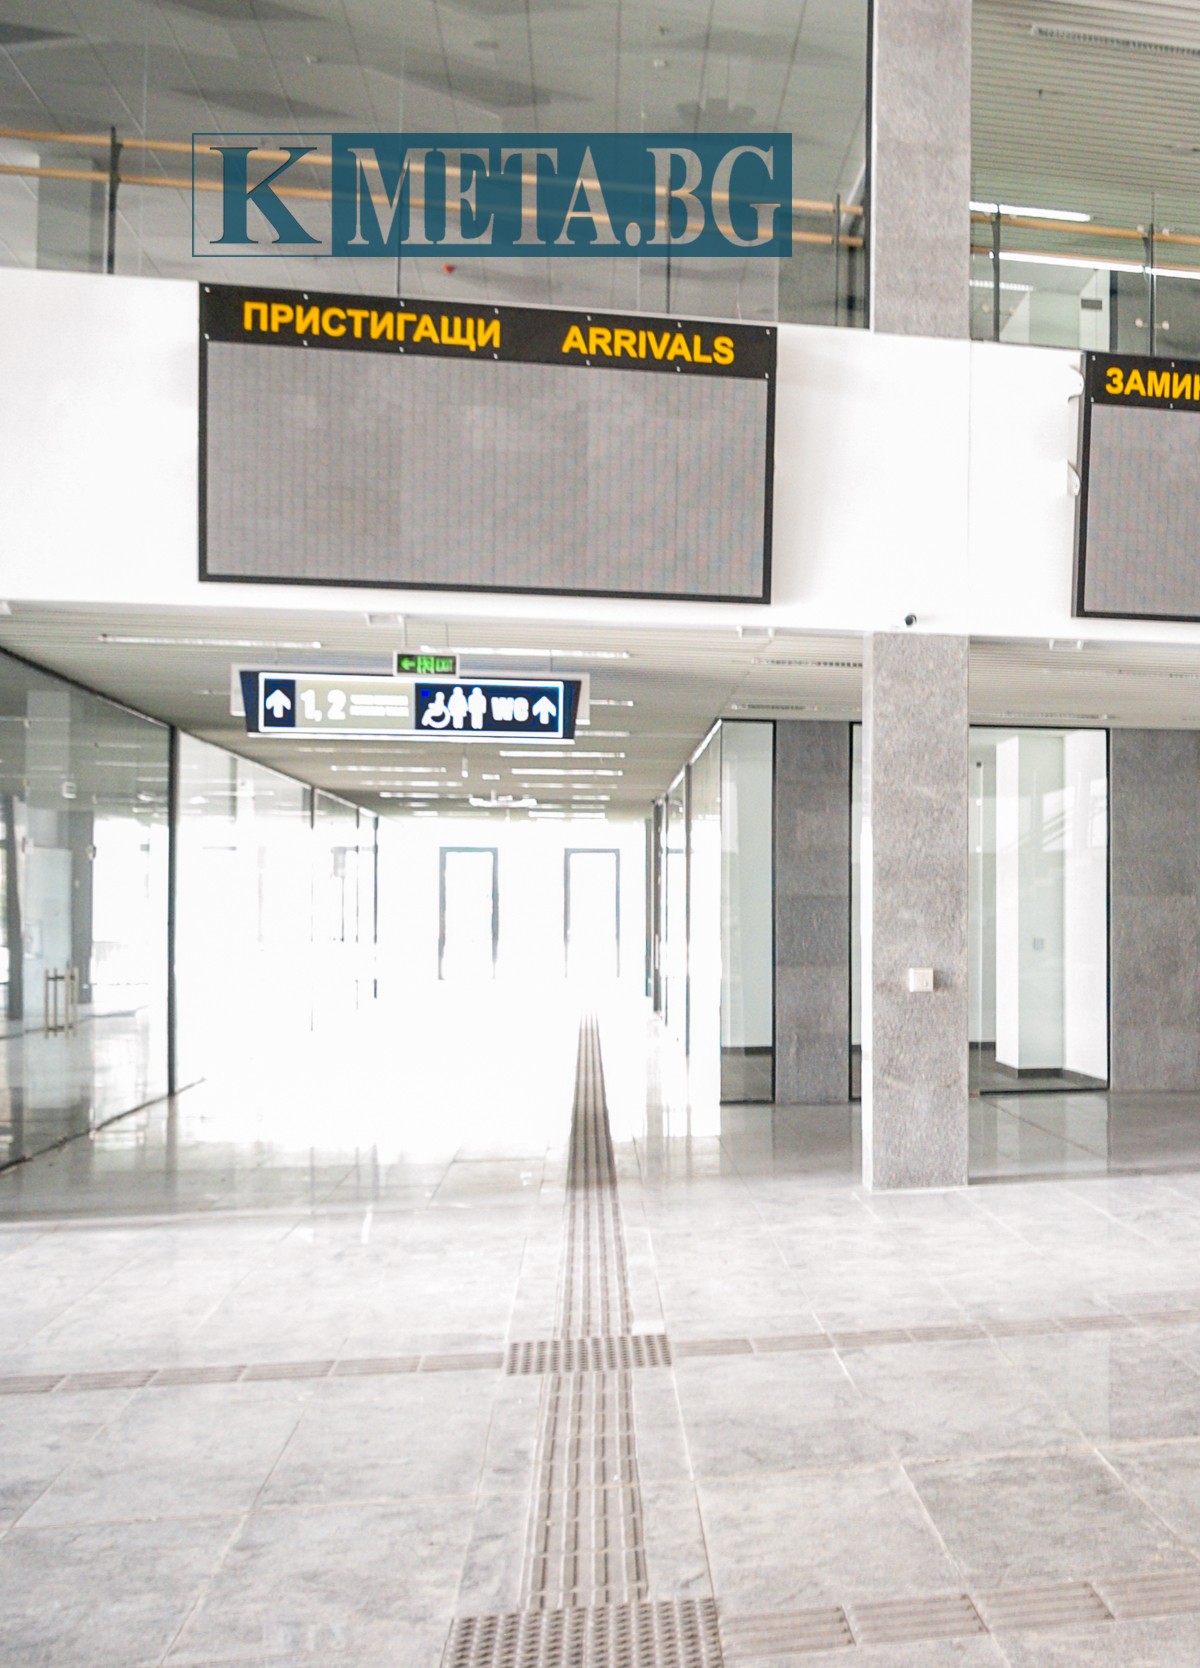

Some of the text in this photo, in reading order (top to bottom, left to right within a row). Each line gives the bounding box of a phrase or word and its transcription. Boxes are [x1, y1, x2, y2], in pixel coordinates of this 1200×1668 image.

[243, 301, 735, 365] ПРИСТИГАЩИ ARRIVALS
[490, 696, 530, 722] WC
